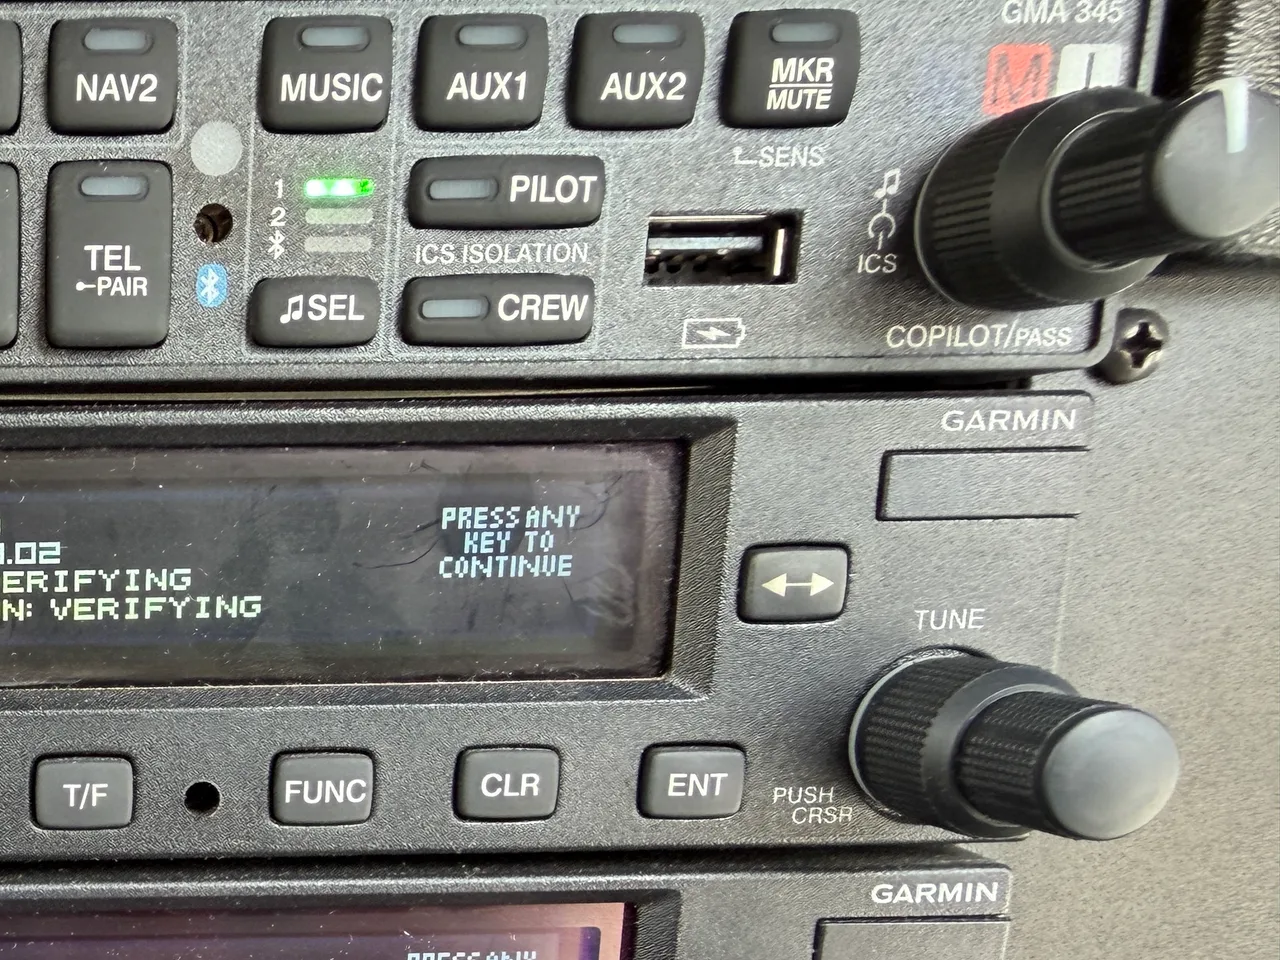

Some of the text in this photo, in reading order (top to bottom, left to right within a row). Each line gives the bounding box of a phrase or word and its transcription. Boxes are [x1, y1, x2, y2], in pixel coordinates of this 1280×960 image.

[1002, 0, 1123, 24] GMA 345
[771, 57, 835, 83] MKR
[76, 74, 157, 102] NAV2
[280, 72, 383, 102] MUSIC
[446, 71, 527, 100] AUX1
[600, 71, 686, 101] AUX2
[766, 89, 832, 110] MUTE
[759, 147, 824, 168] SENS
[275, 180, 283, 198] 1
[509, 175, 597, 203] PILOT
[270, 208, 286, 226] 2
[84, 244, 141, 272] TEL
[415, 242, 588, 264] ICS ISOLATION
[857, 254, 897, 273] ICS
[97, 276, 147, 296] PAIR
[308, 295, 364, 321] SEL
[498, 295, 588, 321] CREW
[887, 324, 1072, 349] COPILOT/PASS
[940, 409, 1077, 432] GARMIN
[441, 505, 580, 530] PRESS ANY
[464, 530, 554, 554] KEY TO
[439, 554, 573, 579] CONTINUE
[50, 596, 262, 621] VERIFYING
[914, 608, 985, 630] TUNE
[63, 783, 108, 810] T/F
[284, 779, 366, 804] FUNC
[480, 773, 540, 798] CLR
[667, 773, 729, 797] ENT
[772, 787, 834, 805] PUSH
[791, 806, 853, 824] CRSR
[870, 882, 999, 904] GARMIN
